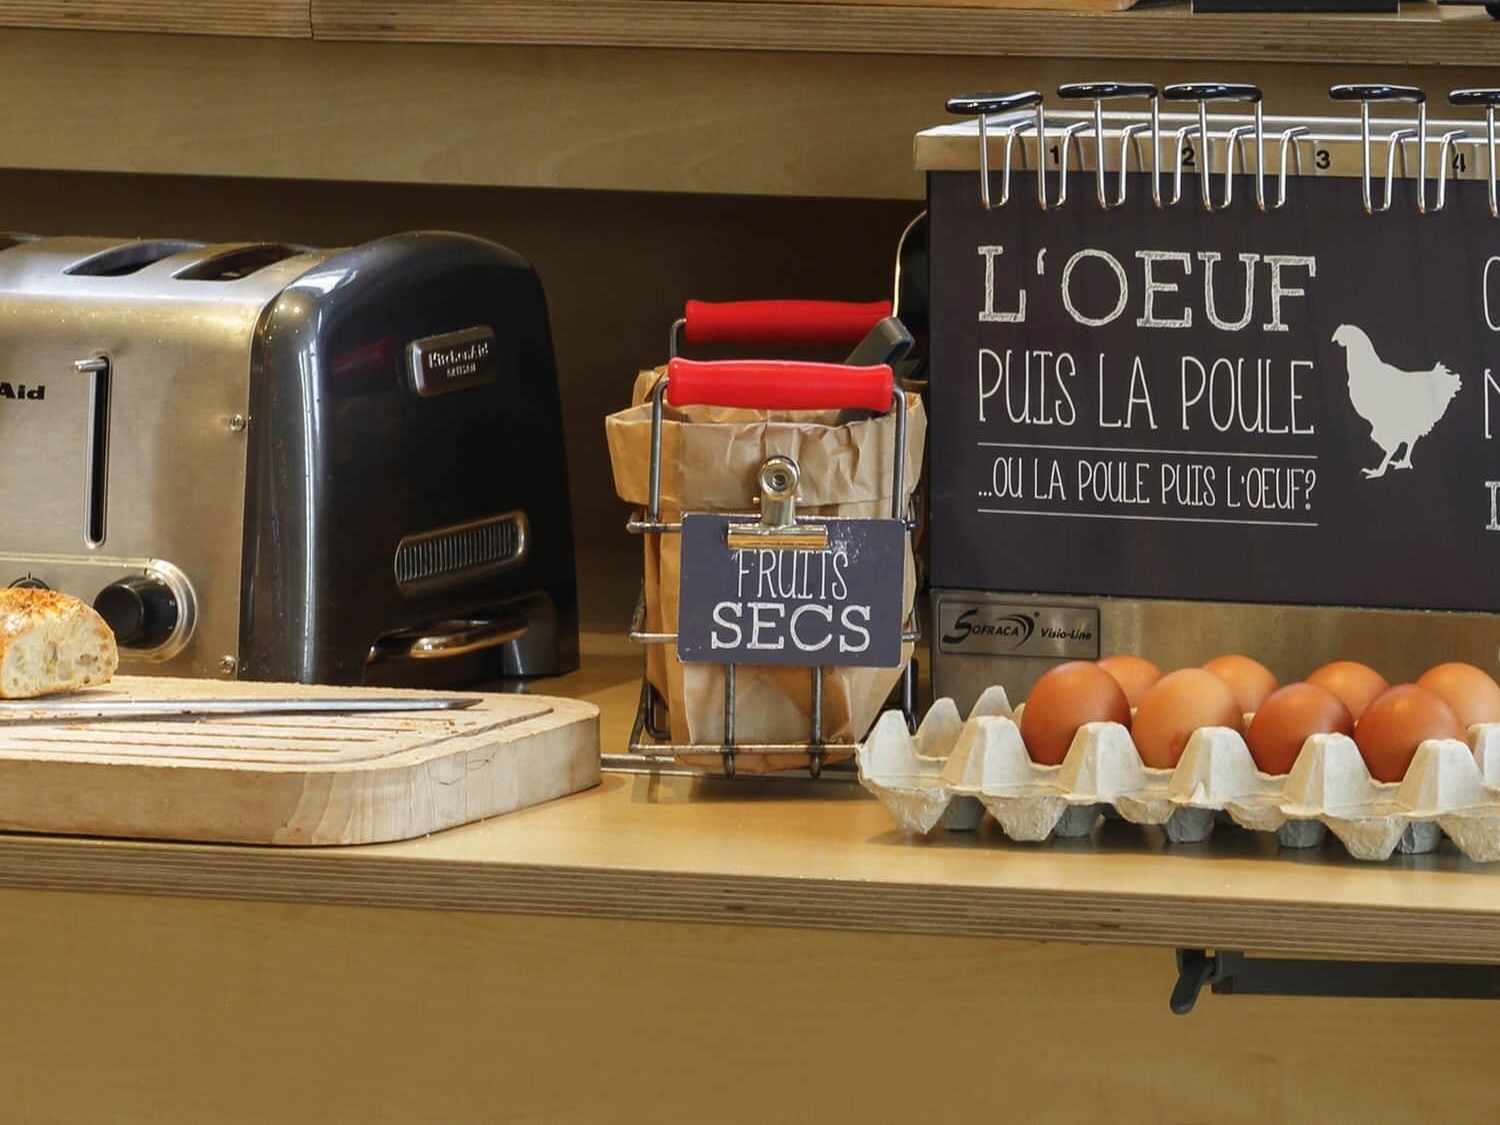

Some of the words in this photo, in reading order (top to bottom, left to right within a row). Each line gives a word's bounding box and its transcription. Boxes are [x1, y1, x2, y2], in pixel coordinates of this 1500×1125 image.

[1049, 140, 1060, 164] 1
[1181, 148, 1196, 166] 2
[1315, 150, 1331, 169] 3
[1452, 153, 1466, 173] 4
[978, 245, 1317, 332] L'OEUF
[978, 348, 1076, 426] PUIS
[1099, 353, 1158, 429] LA
[1182, 356, 1315, 435] POULE
[1034, 458, 1066, 500] LA
[1078, 460, 1150, 504] POULE
[1162, 464, 1216, 507] PUIS
[1227, 466, 1317, 510] L'OEUF?
[738, 549, 849, 600] FRUITS
[711, 601, 871, 653] SECS
[942, 607, 1020, 645] SOFRACA
[1040, 628, 1092, 641] Visio-Line
